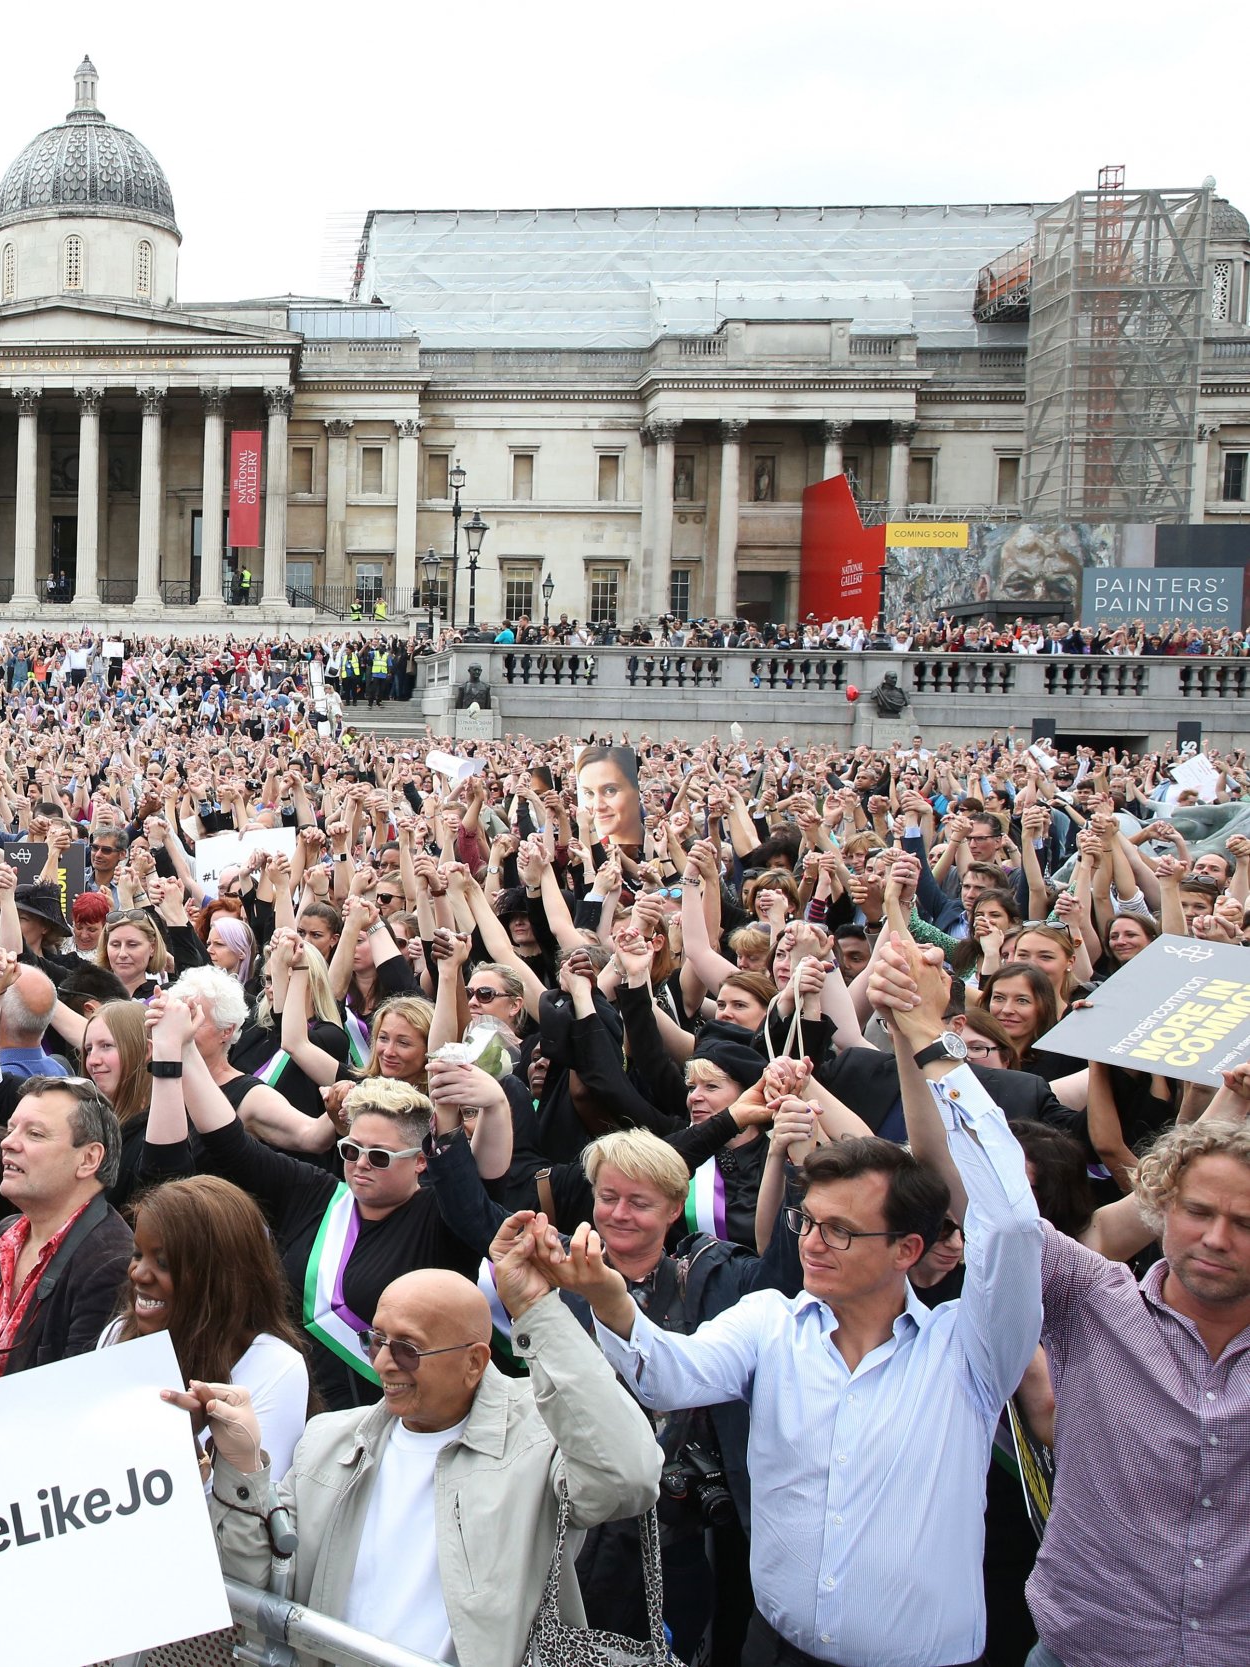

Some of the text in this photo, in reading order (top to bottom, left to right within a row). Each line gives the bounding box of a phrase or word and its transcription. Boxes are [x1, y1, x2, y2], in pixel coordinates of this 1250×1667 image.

[98, 360, 190, 371] GALLERY
[238, 450, 248, 504] NATIONAL
[247, 450, 258, 504] GALLERY
[894, 530, 959, 538] COMING SOON
[841, 572, 863, 587] GALLERY
[842, 562, 863, 575] NATIONAL
[1095, 597, 1229, 613] PAINTINGS
[1107, 976, 1209, 1055] #moreincommon
[1128, 978, 1244, 1062] MORE IN
[1164, 984, 1250, 1067] COMMO
[1207, 1050, 1242, 1075] Amnesty
